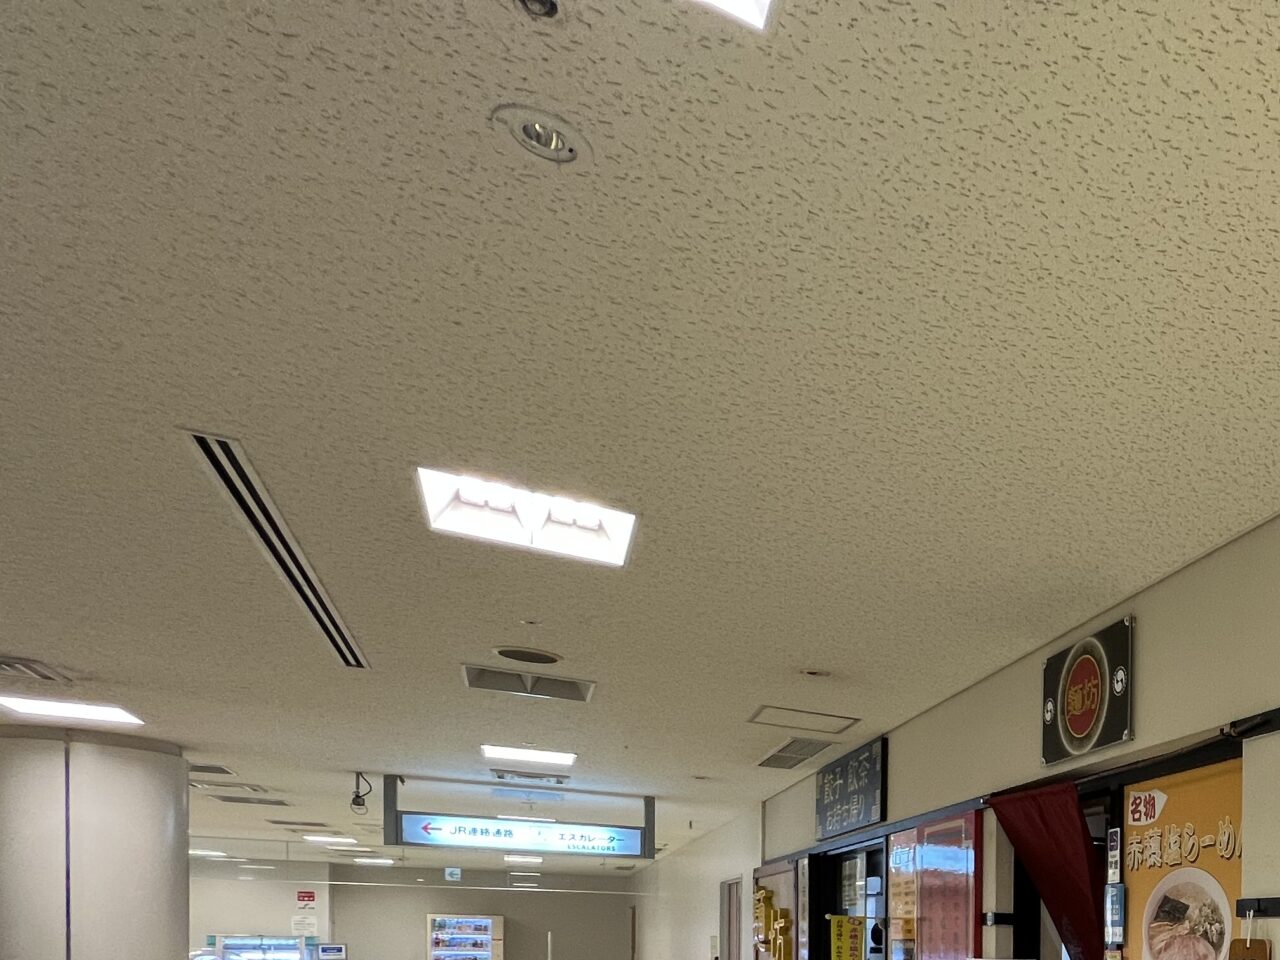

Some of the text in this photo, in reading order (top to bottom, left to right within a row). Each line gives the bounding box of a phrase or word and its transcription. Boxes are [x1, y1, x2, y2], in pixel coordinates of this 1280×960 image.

[1131, 794, 1156, 822] 名物
[1126, 815, 1243, 872] 赤穂塩らーめ
